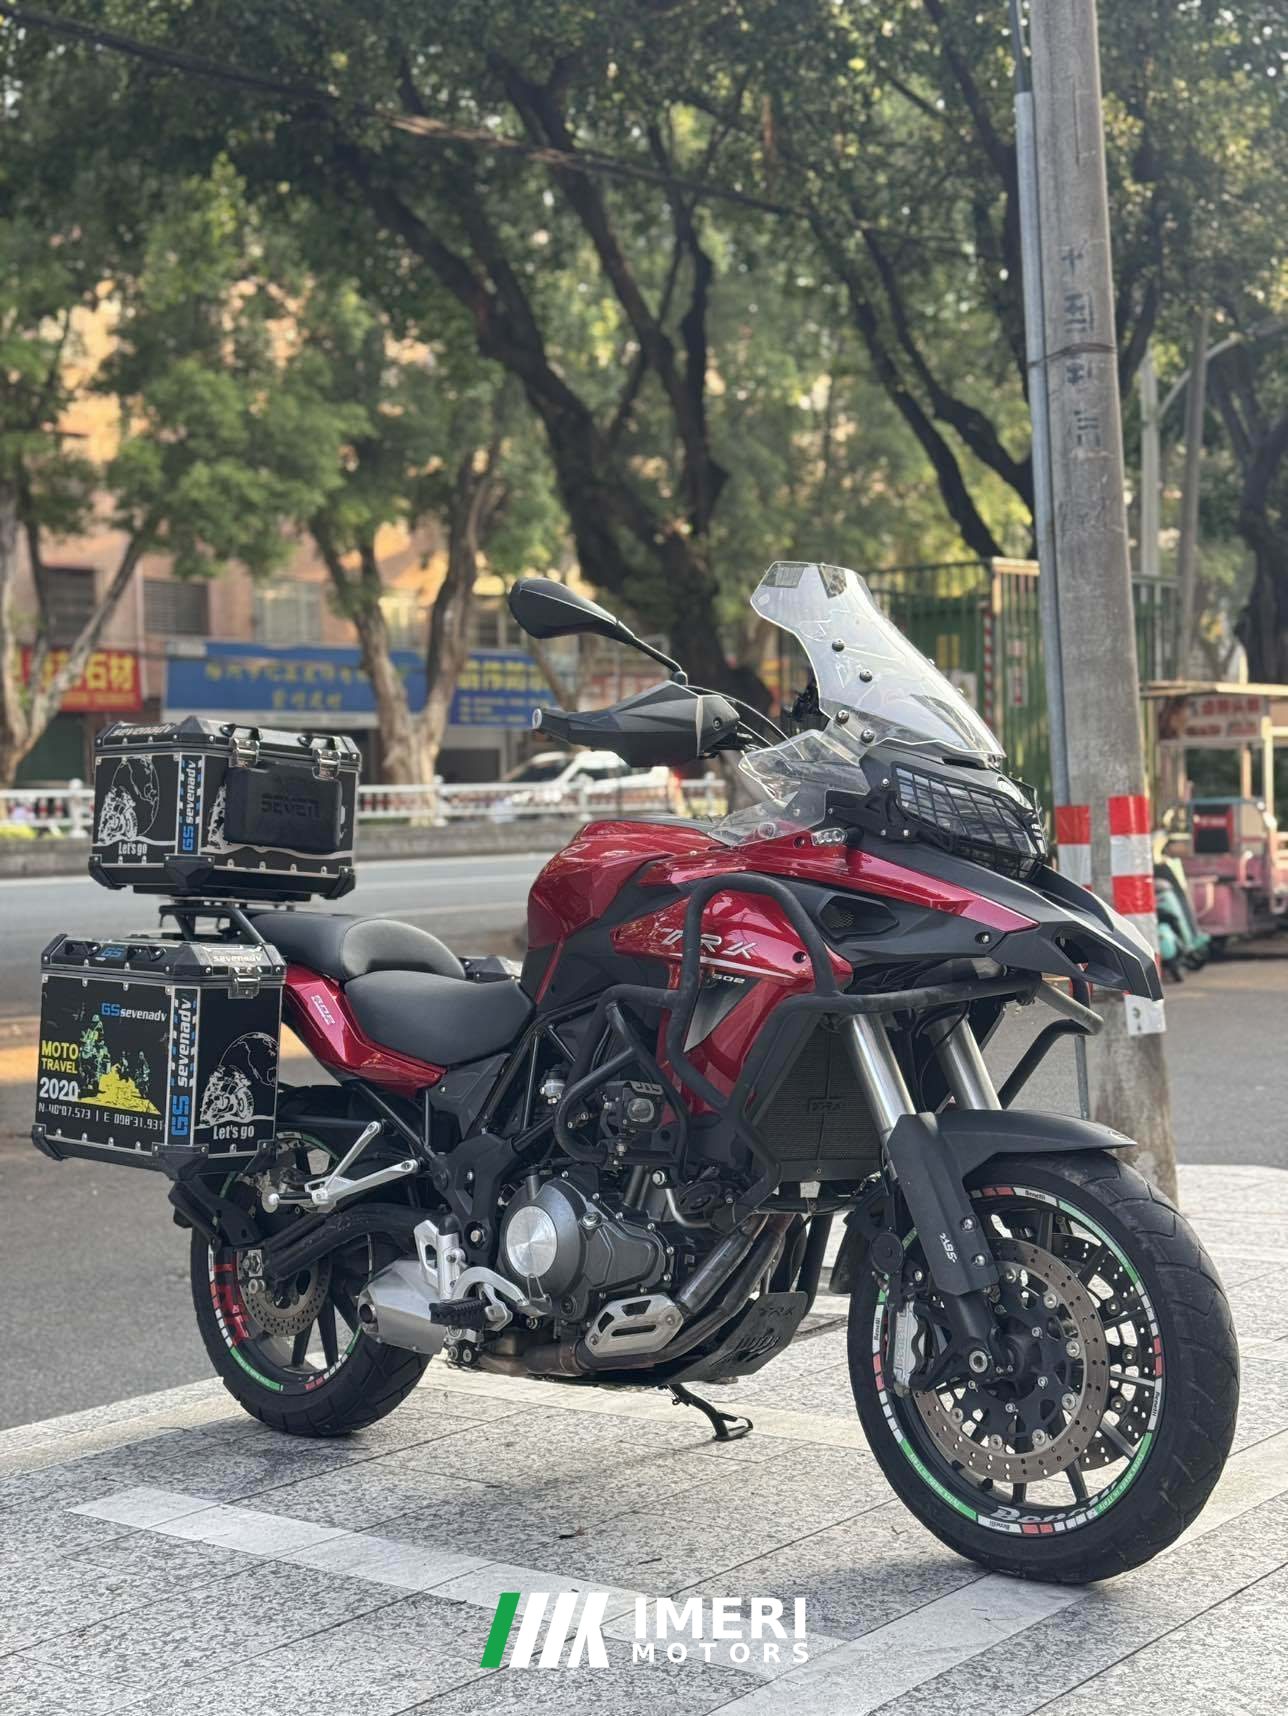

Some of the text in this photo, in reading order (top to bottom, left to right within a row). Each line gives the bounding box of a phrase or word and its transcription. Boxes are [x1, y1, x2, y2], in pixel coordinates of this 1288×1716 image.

[185, 760, 197, 824] sevenadv
[136, 842, 147, 856] go
[101, 948, 124, 958] GS
[41, 1040, 79, 1060] MOTO
[41, 1058, 78, 1074] TRAVEL
[171, 998, 192, 1136] GS sevenadv
[39, 1076, 79, 1102] 2020
[213, 1125, 255, 1140] Let's go
